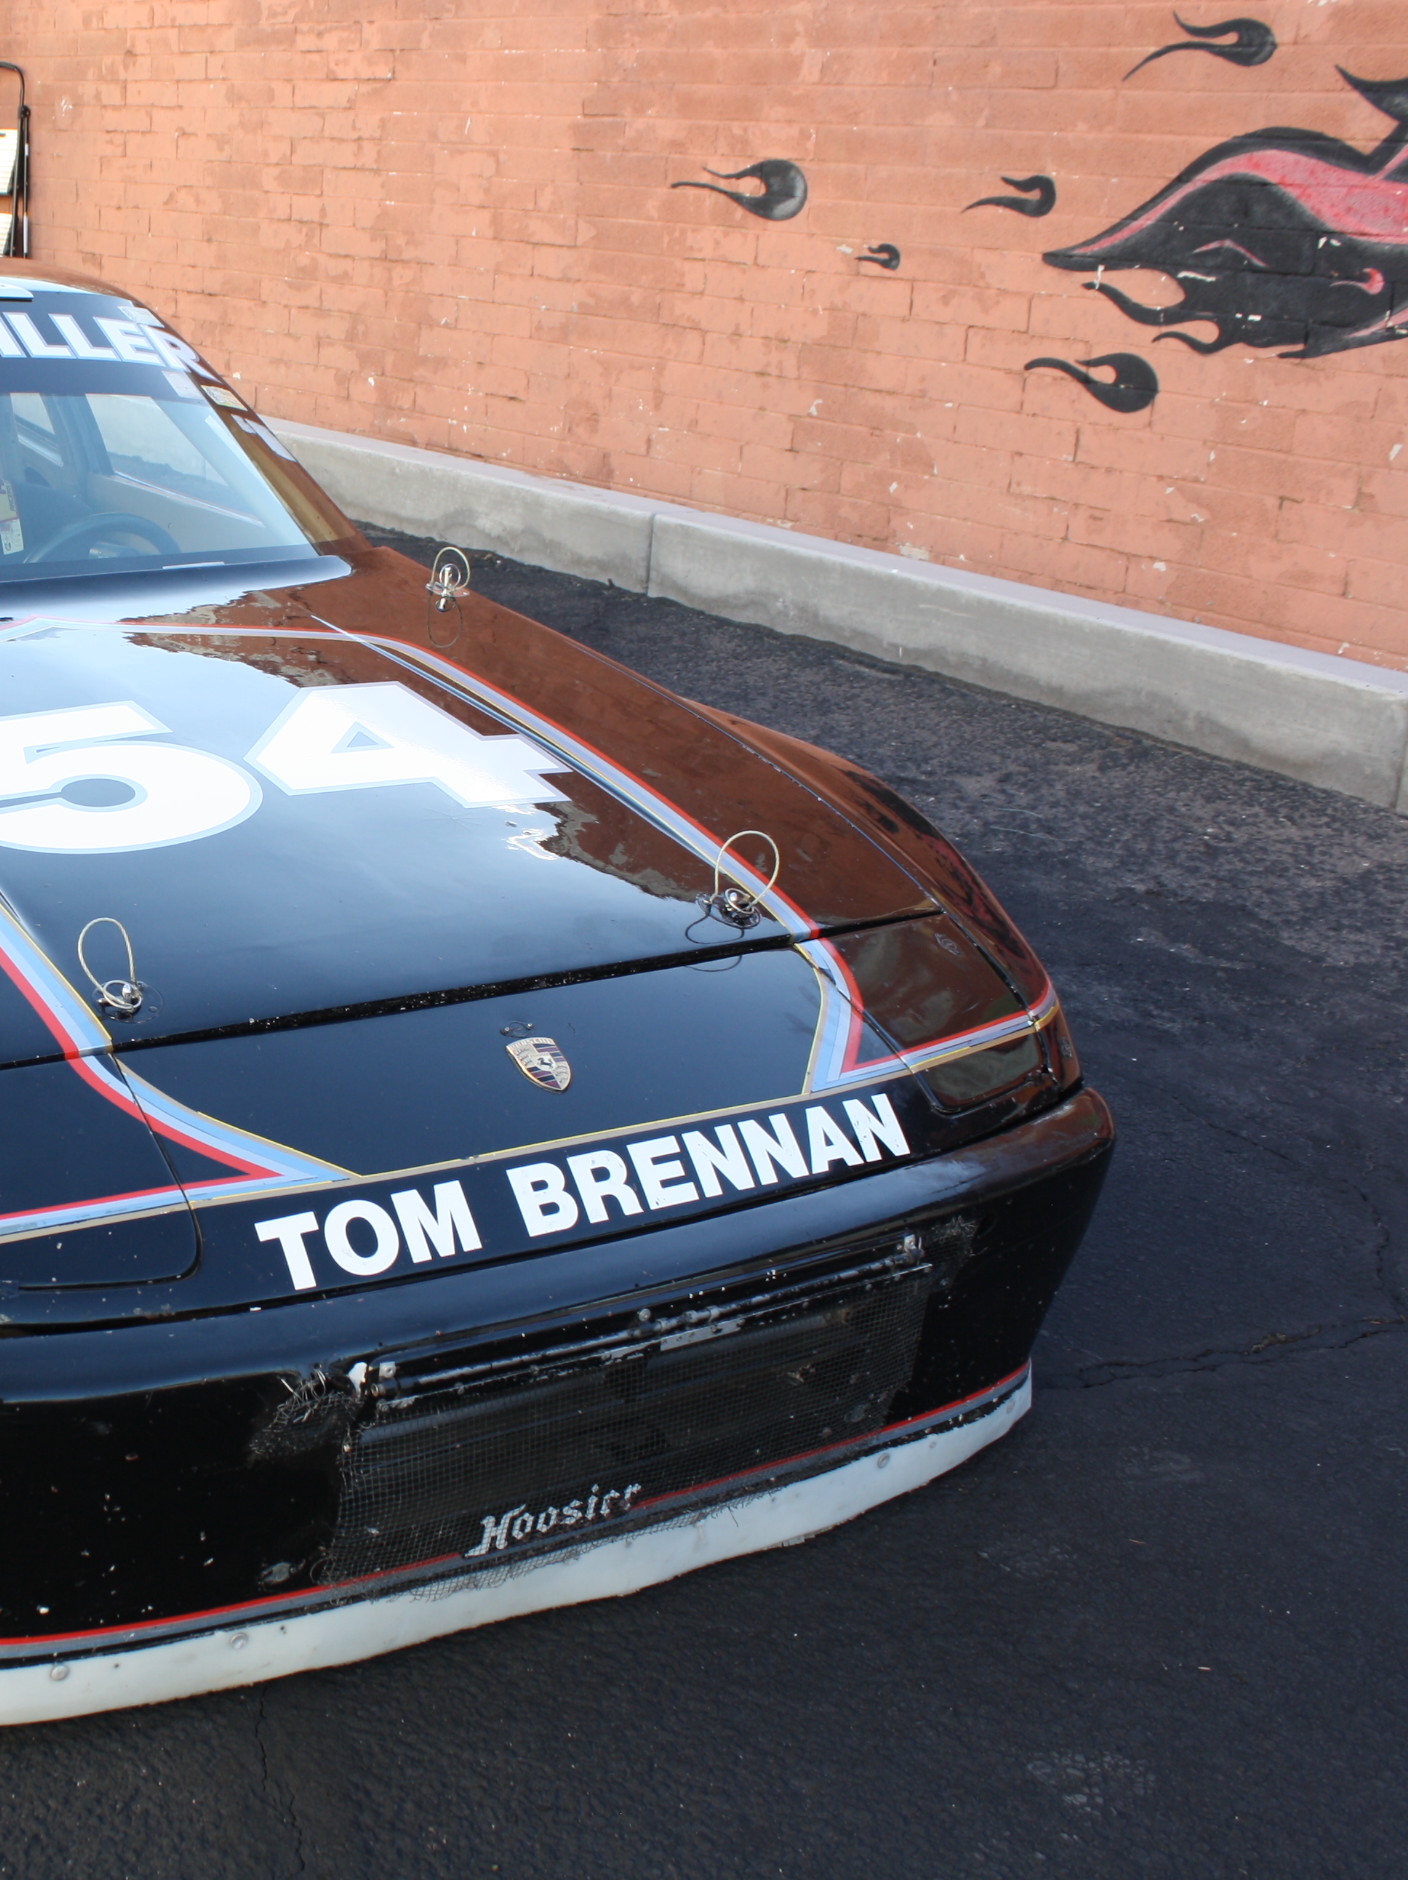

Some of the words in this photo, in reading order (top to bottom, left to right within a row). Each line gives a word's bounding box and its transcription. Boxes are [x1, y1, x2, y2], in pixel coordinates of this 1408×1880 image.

[255, 1180, 482, 1291] TOM
[506, 1093, 911, 1238] BRENNAN
[464, 1483, 642, 1558] Hoosier
